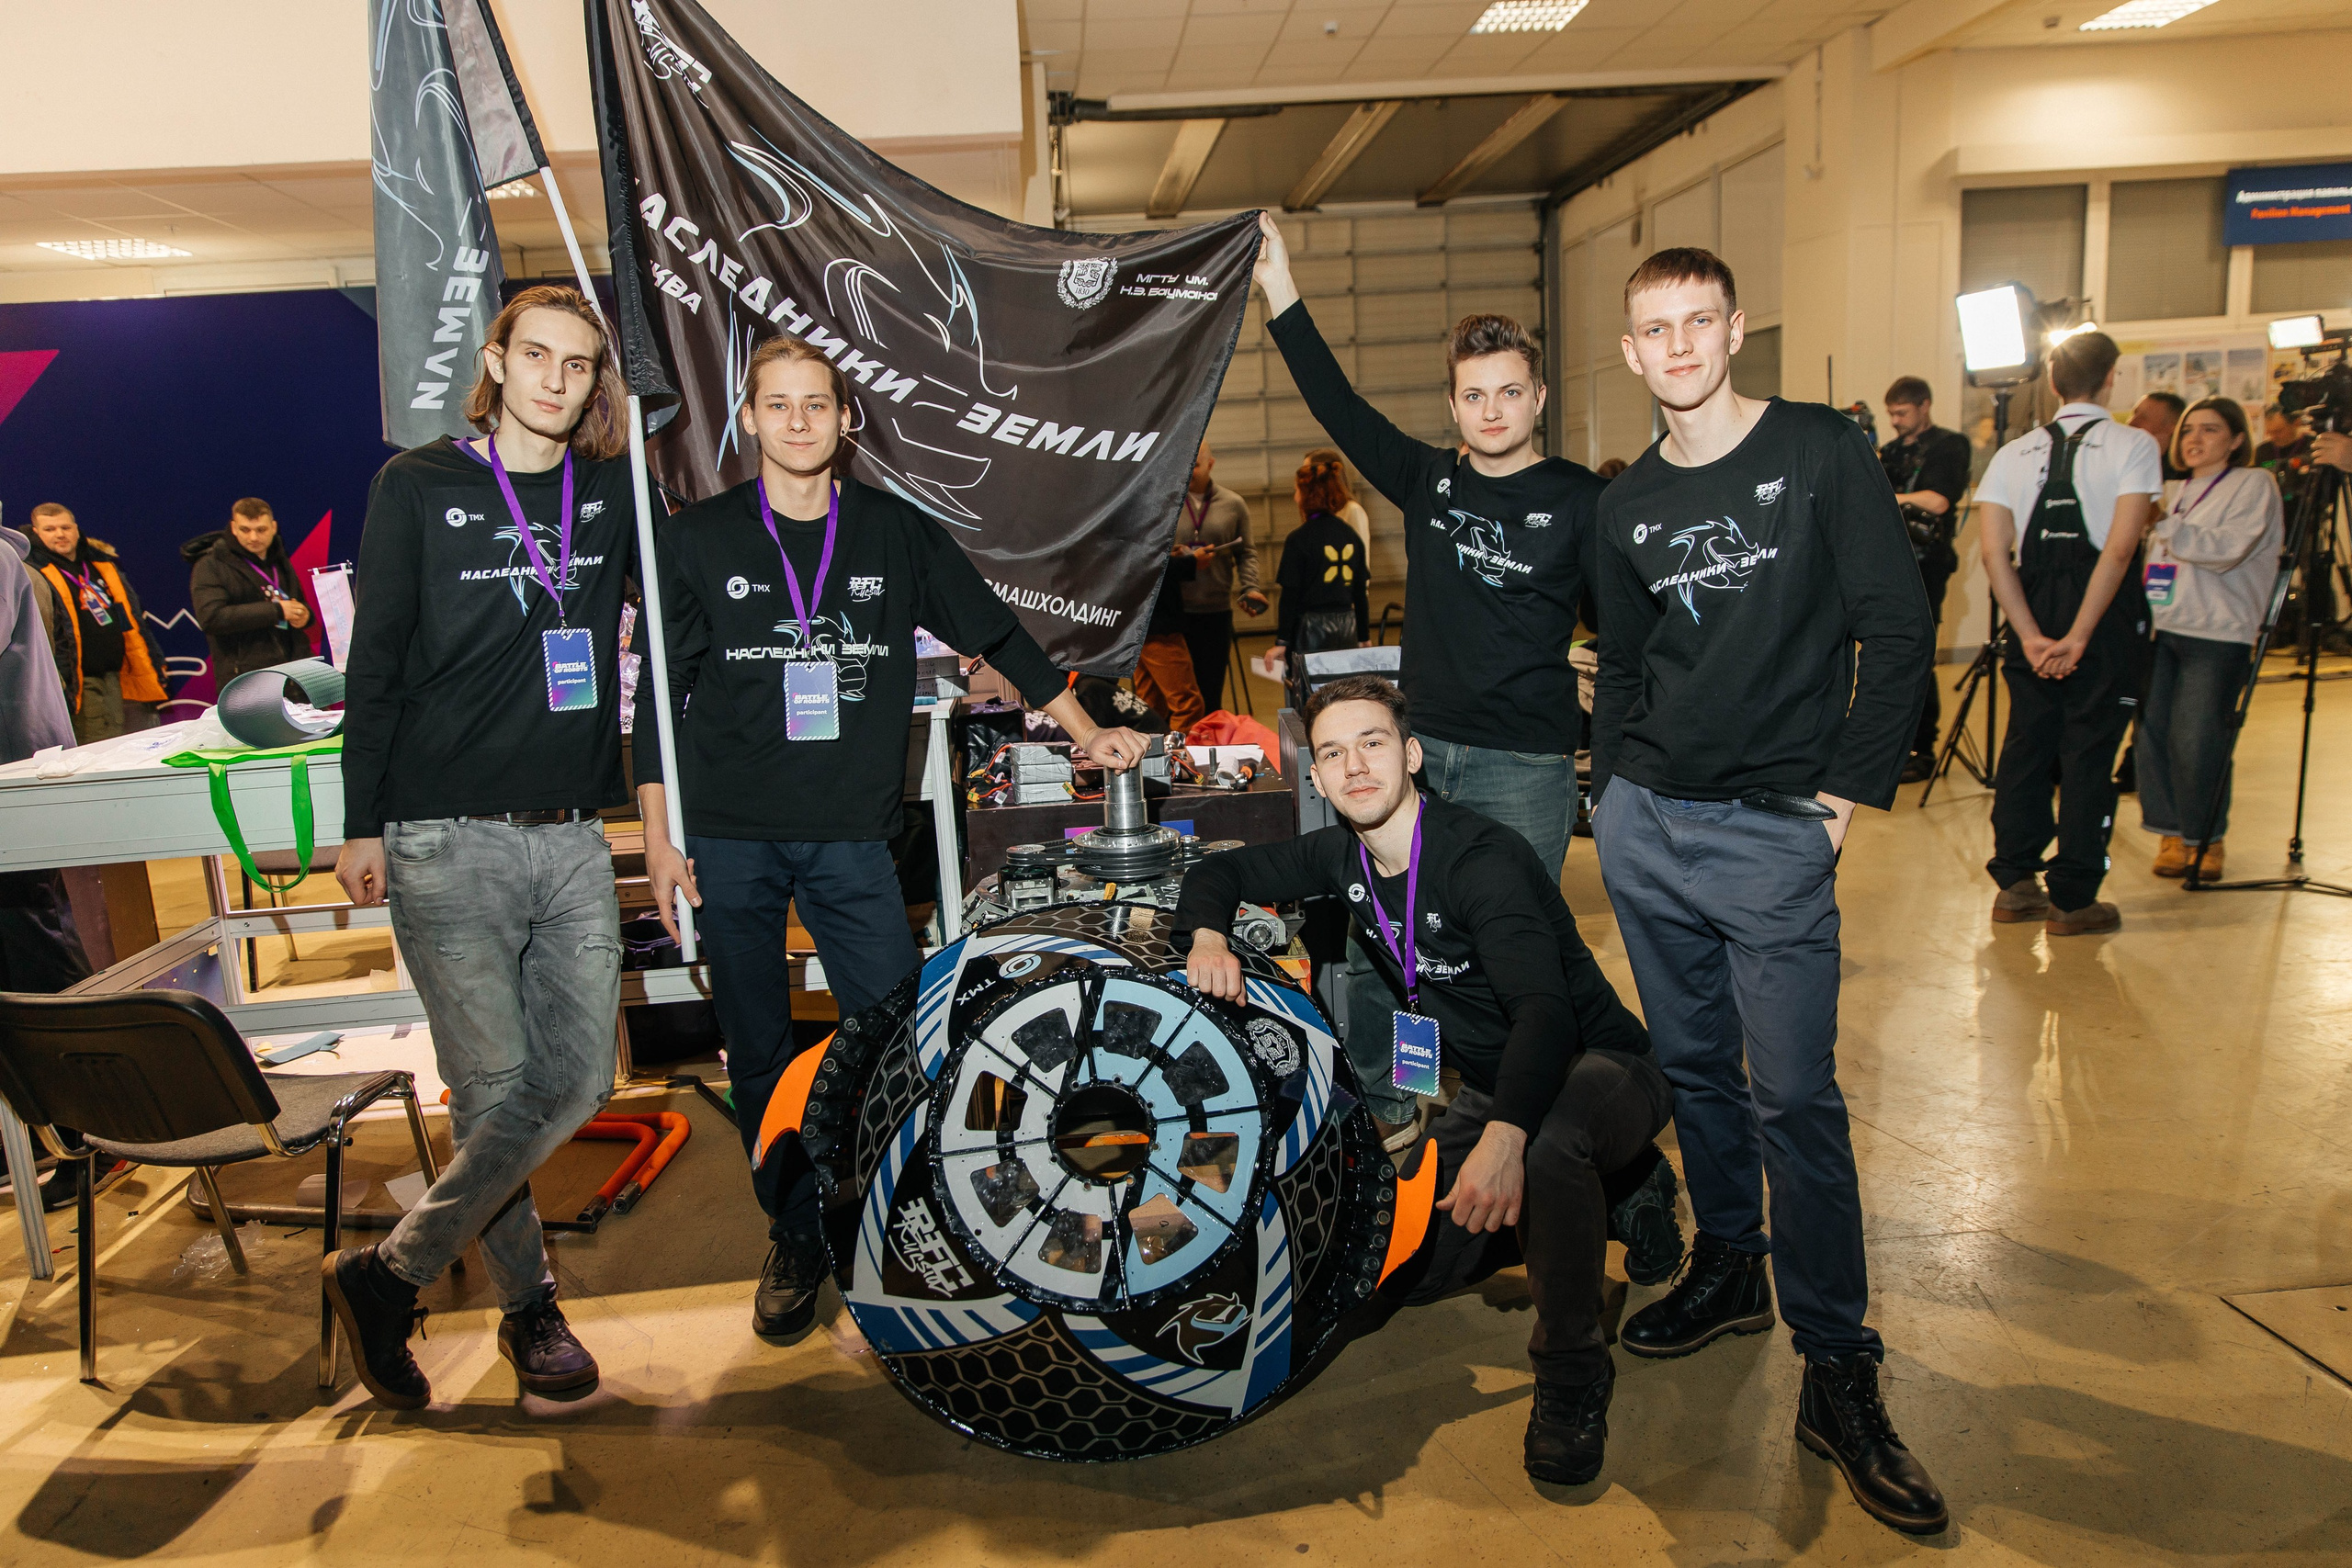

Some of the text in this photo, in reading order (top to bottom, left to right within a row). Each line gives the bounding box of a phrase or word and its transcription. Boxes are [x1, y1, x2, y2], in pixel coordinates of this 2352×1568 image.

[1136, 273, 1181, 284] МГТУ
[650, 261, 703, 315] КВА
[1074, 287, 1091, 296] 1830
[636, 184, 1160, 462] АСЛЕДНИКИ ЗЕМЛИ
[1489, 555, 1533, 574] ЗЕМЛИ
[1402, 1059, 1430, 1069] participant
